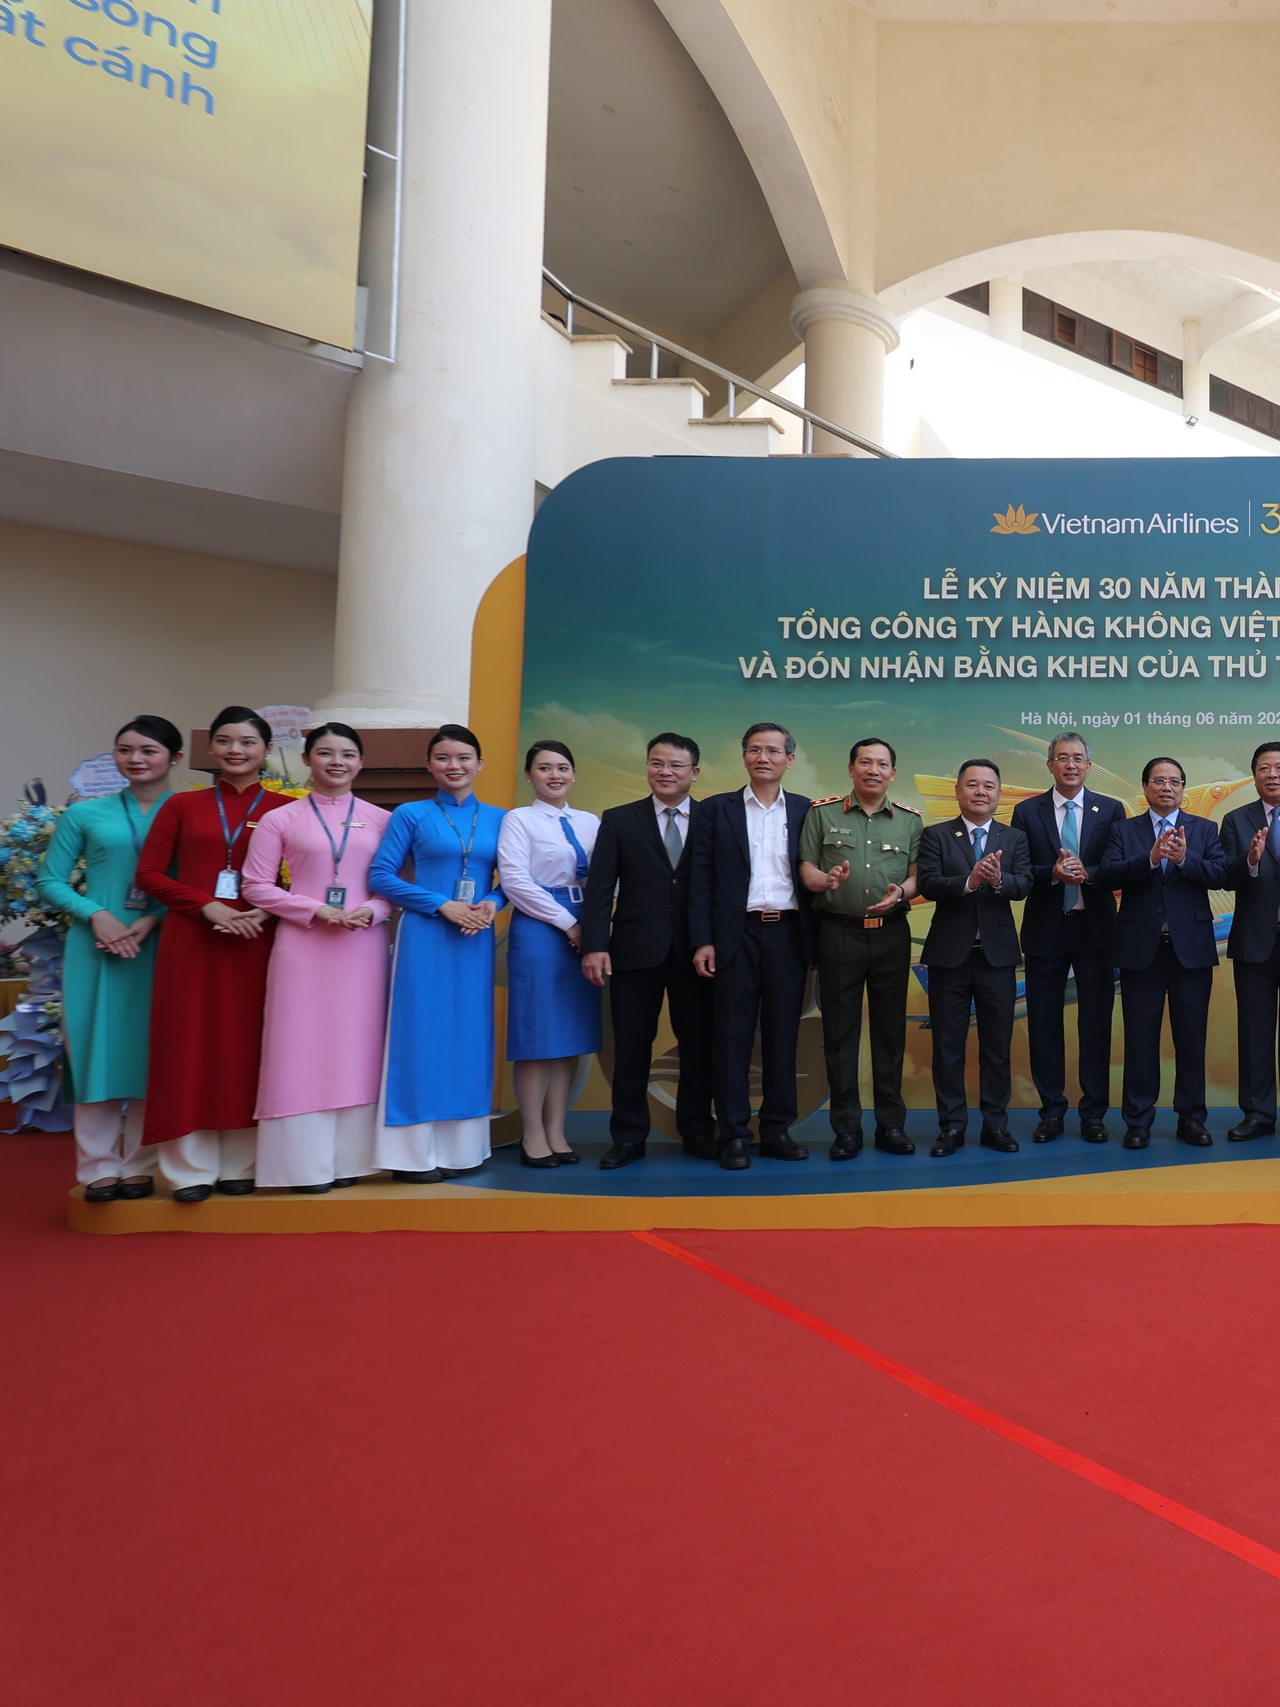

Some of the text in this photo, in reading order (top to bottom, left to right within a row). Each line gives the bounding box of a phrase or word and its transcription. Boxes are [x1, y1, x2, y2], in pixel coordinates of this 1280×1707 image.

[63, 35, 215, 115] cánh
[1041, 512, 1239, 535] Vietnam Airlines
[923, 567, 959, 600] LỄ
[968, 571, 1008, 599] KỶ
[1016, 571, 1090, 604] NIỆM
[1098, 577, 1132, 600] 30
[1140, 571, 1206, 599] NĂM
[777, 607, 861, 640] TỔNG
[870, 610, 957, 639] CÔNG
[965, 616, 1004, 639] TY
[1012, 610, 1095, 639] HÀNG
[1105, 610, 1211, 639] KHÔNG
[738, 650, 778, 679] VÀ
[784, 650, 851, 679] ĐÓN
[860, 650, 944, 683] NHẬN
[954, 645, 1038, 678] BẰNG
[1047, 655, 1128, 678] KHEN
[1137, 649, 1200, 678] CỦA
[1207, 649, 1267, 678] THỦ
[1021, 711, 1042, 725] Hà
[1046, 711, 1077, 728] Nội,
[1082, 711, 1120, 728] ngày
[1123, 712, 1141, 725] 01
[1146, 711, 1192, 728] tháng
[1195, 711, 1215, 725] 06
[1219, 711, 1253, 725] năm
